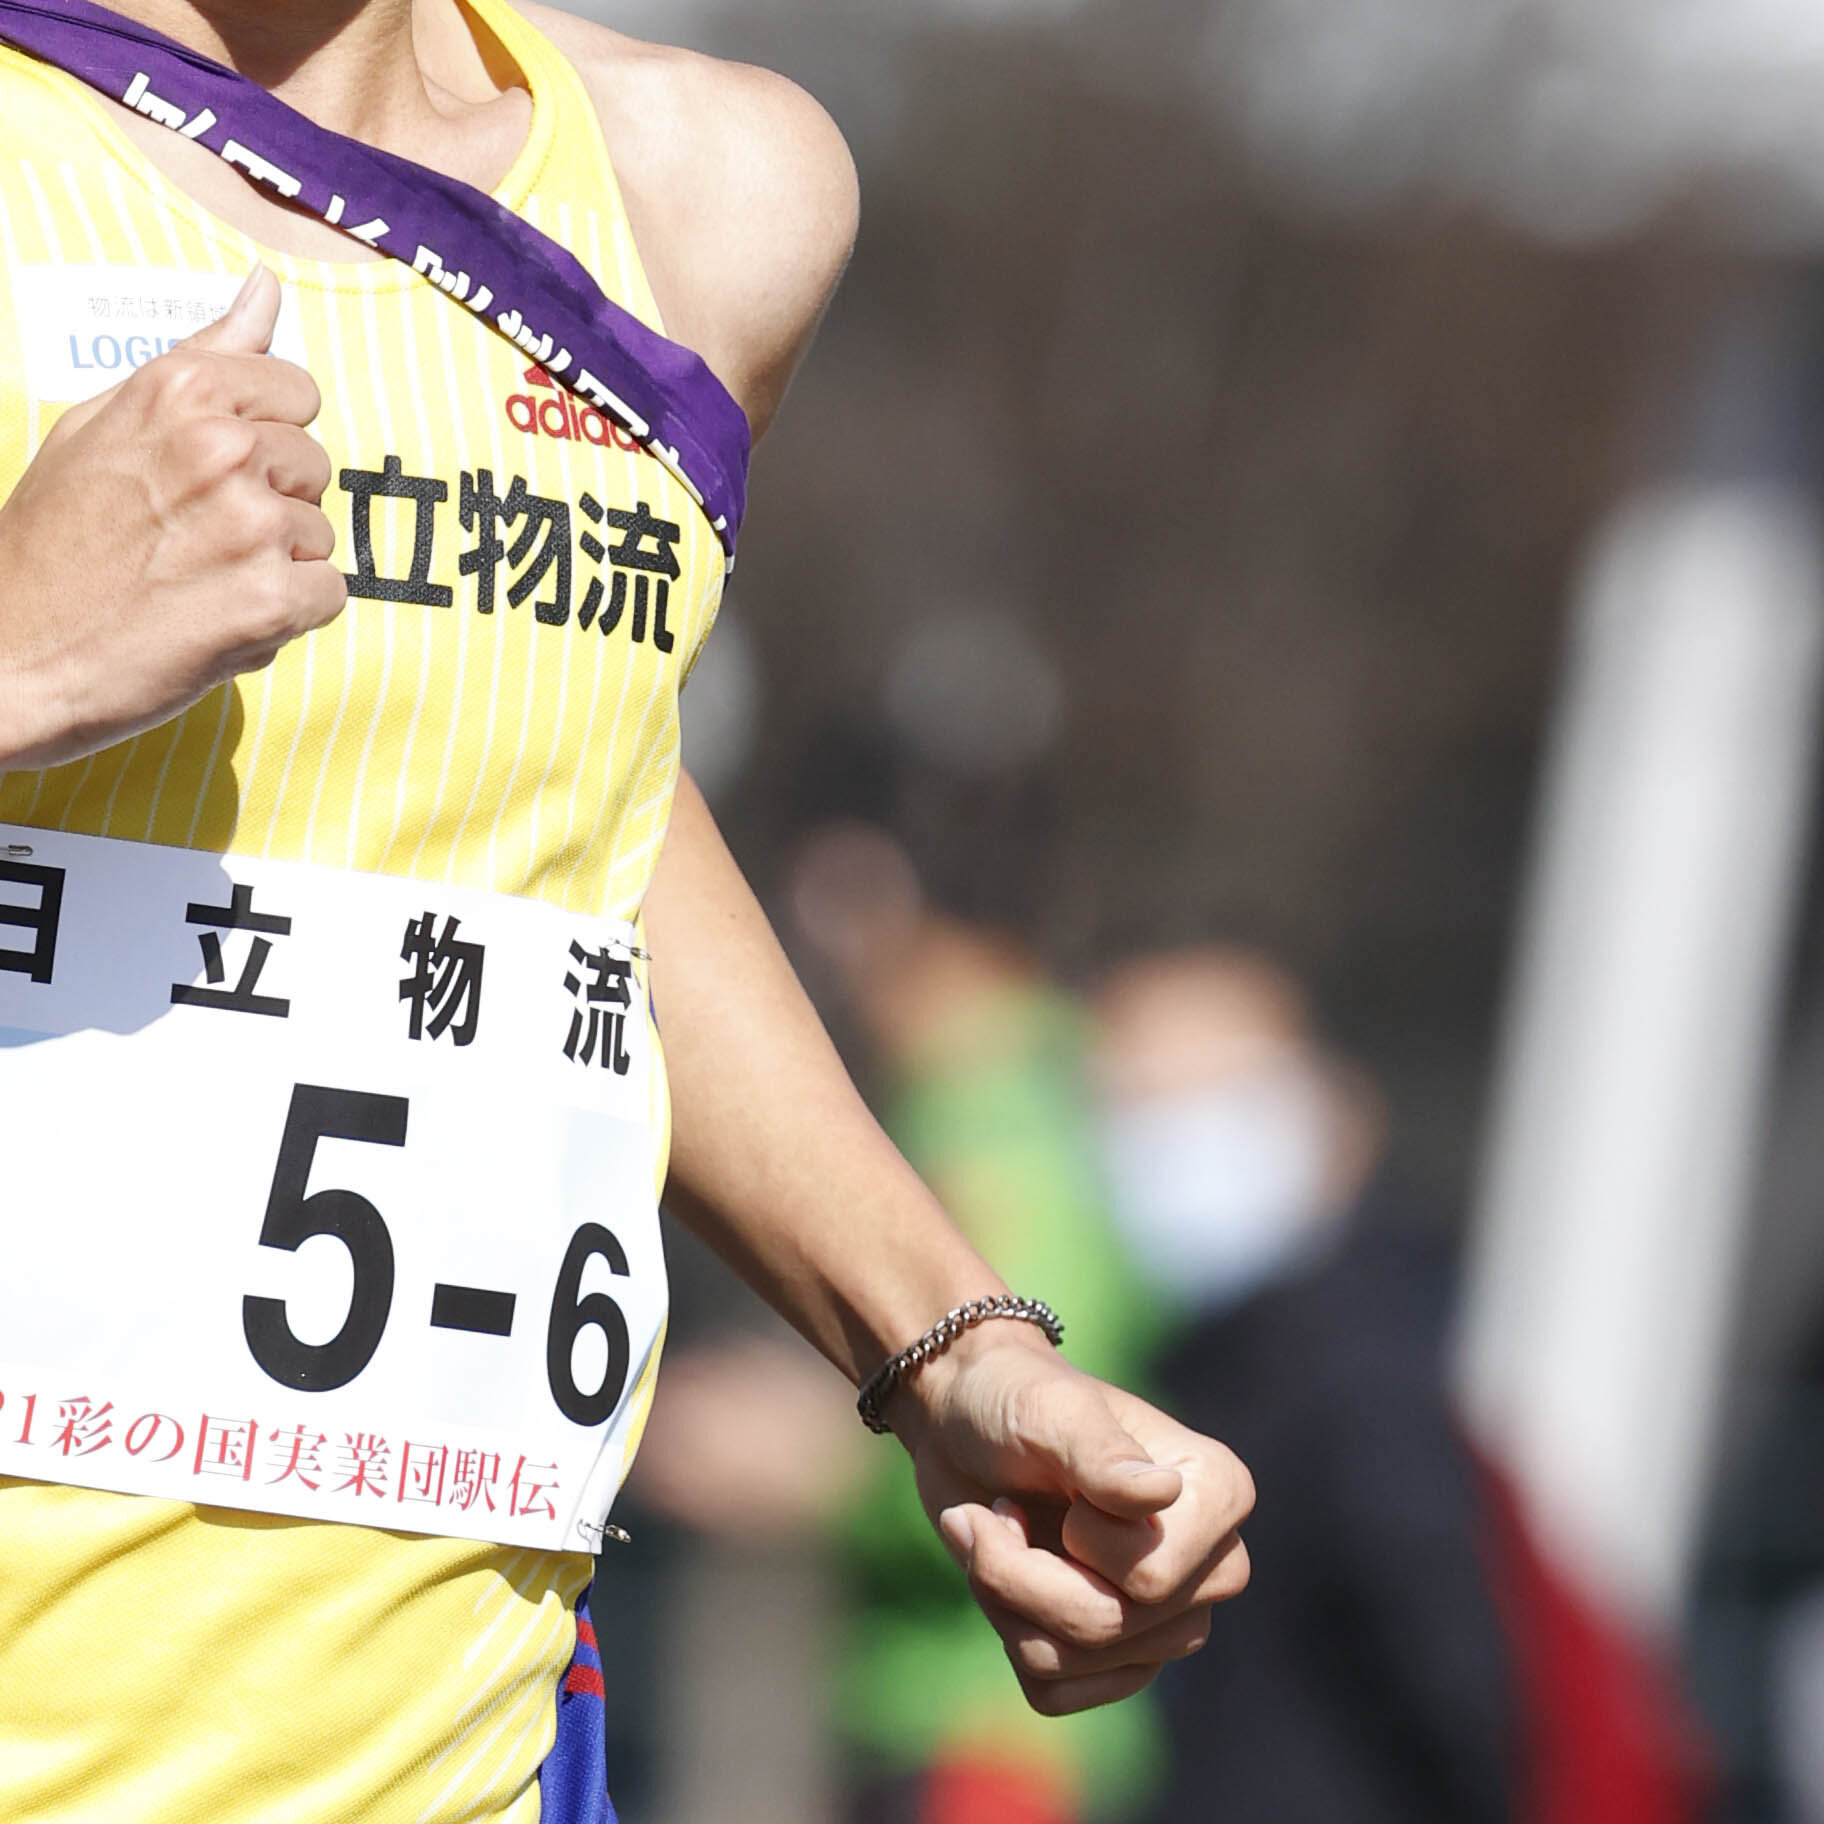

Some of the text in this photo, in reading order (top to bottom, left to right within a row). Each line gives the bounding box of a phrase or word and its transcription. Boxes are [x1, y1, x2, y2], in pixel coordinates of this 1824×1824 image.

[505, 389, 657, 459] adida
[319, 455, 681, 654] 立物流
[241, 1082, 632, 1428] 5-6
